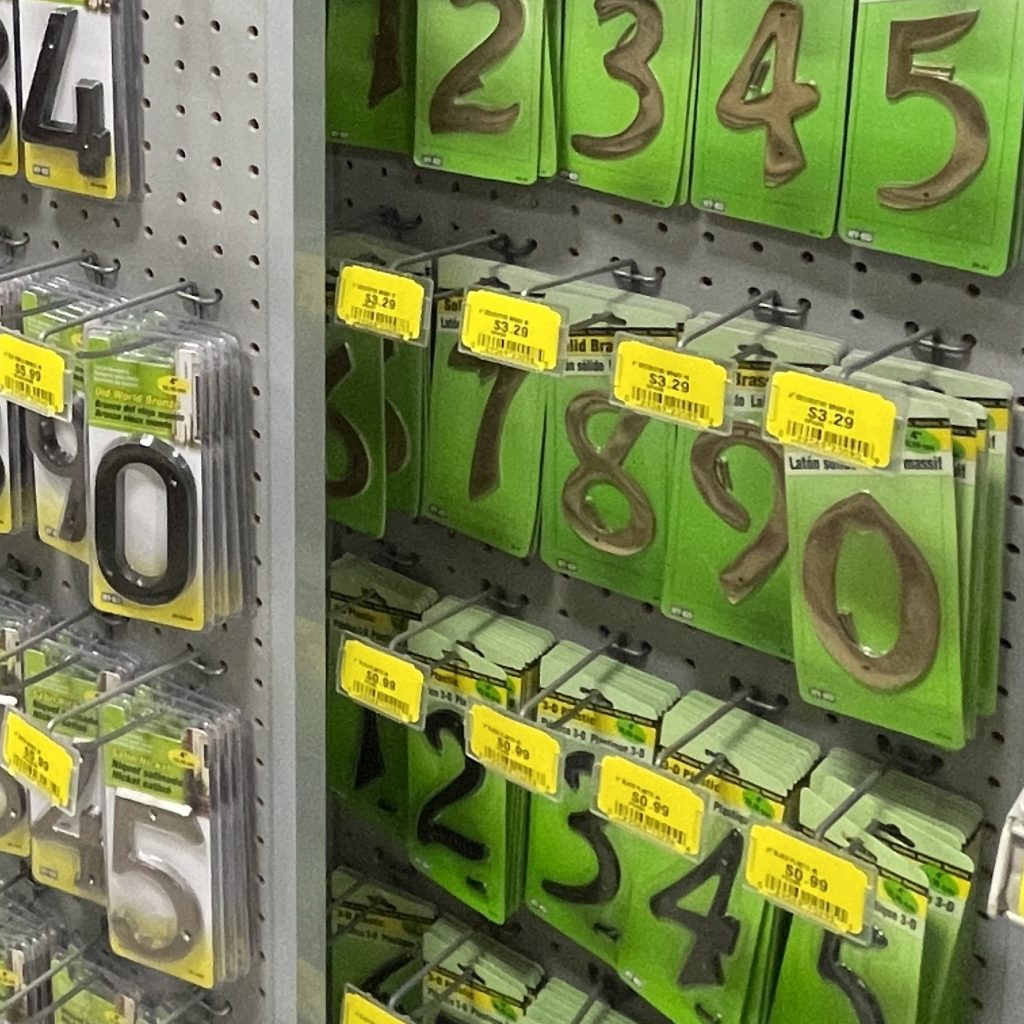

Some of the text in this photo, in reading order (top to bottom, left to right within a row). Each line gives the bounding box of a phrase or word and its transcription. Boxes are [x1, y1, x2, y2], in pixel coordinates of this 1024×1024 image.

[21, 6, 111, 177] 4
[877, 9, 991, 211] 5
[14, 363, 42, 383] $5.99
[363, 293, 396, 310] $3.29
[494, 320, 529, 338] $3.29
[447, 341, 529, 503] 7
[648, 373, 690, 393] $3.29
[807, 406, 855, 430] $3.29
[95, 435, 198, 606] 0
[562, 389, 657, 556] 8
[690, 421, 789, 606] 9
[802, 488, 941, 695] 0
[365, 670, 397, 692] $0.99
[496, 737, 530, 761] $0.99
[417, 709, 490, 862] 2
[631, 792, 670, 817] $0.99
[112, 793, 206, 963] 5
[650, 828, 746, 986] 4
[784, 864, 828, 893] $0.99
